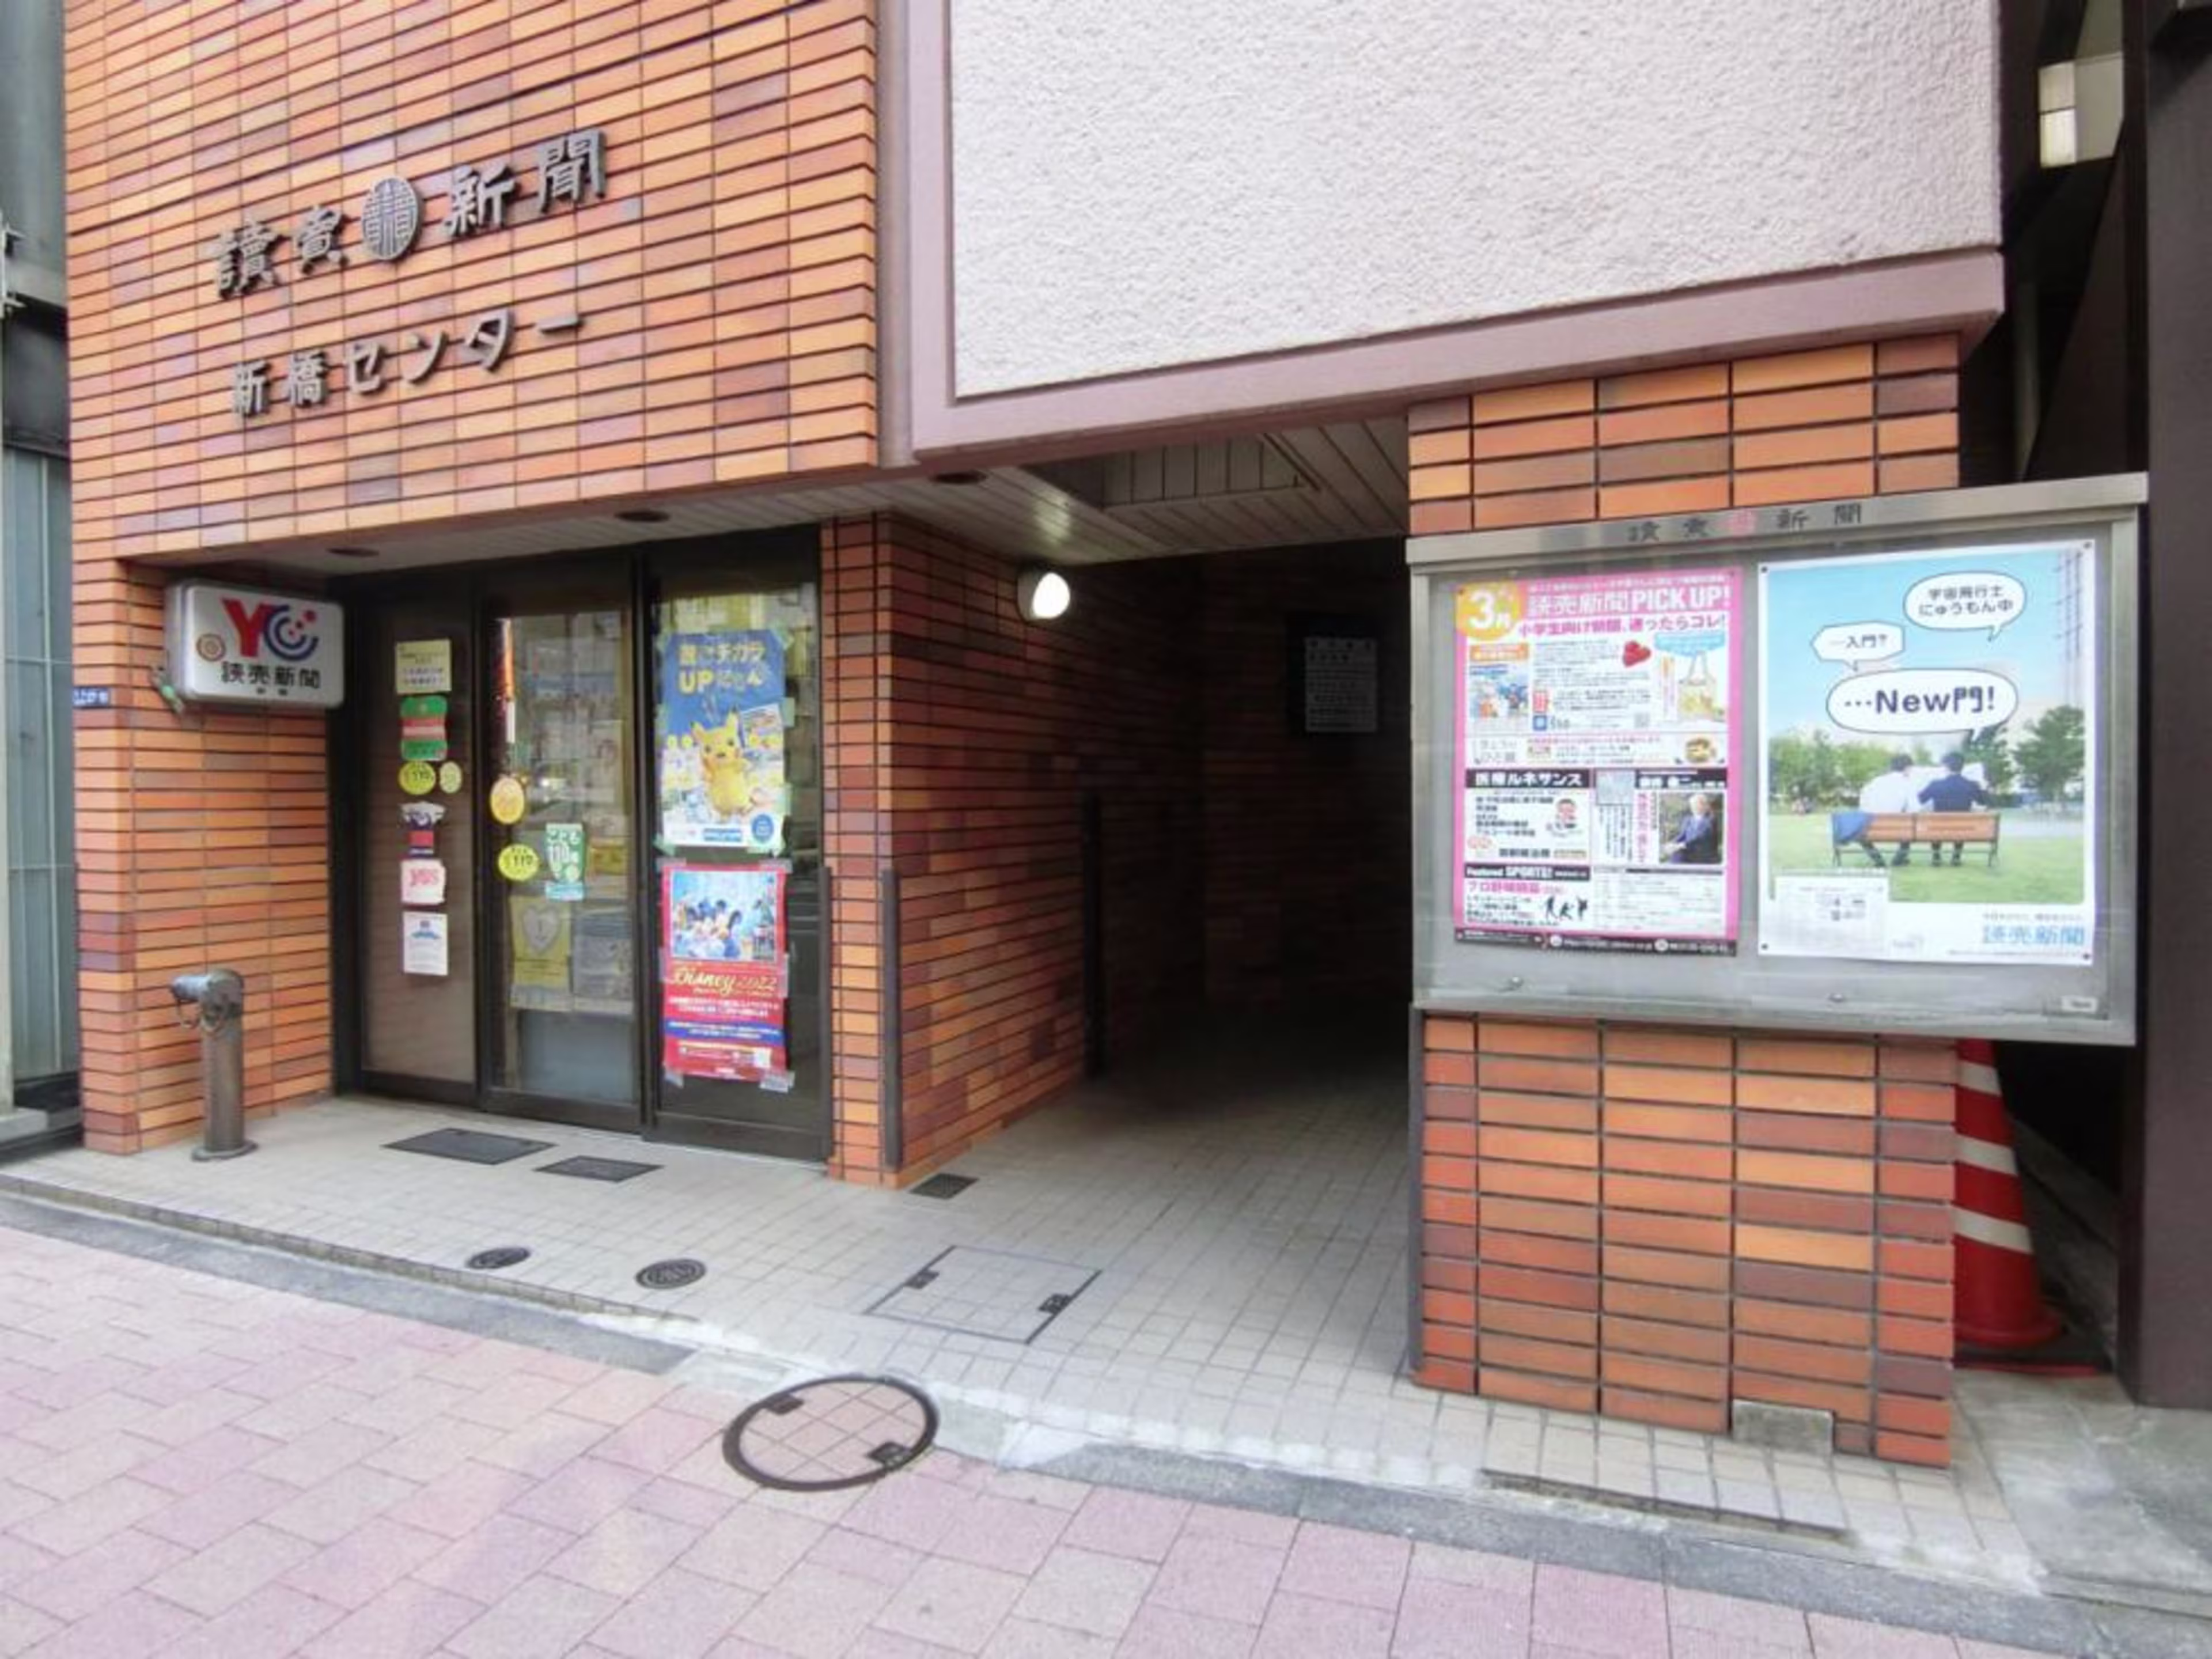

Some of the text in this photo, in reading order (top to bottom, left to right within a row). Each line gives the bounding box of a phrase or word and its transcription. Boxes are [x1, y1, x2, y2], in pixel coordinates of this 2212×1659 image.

[232, 306, 583, 417] 新橋センター
[1528, 585, 1730, 618] 読売新聞 PICK UP!
[1927, 585, 2005, 600] 宇宙飛行士
[1918, 600, 2014, 618] にゅうもん中
[219, 597, 320, 662] YC
[221, 661, 322, 690] 読売新聞
[1475, 771, 1582, 786] 医療ルネサンス
